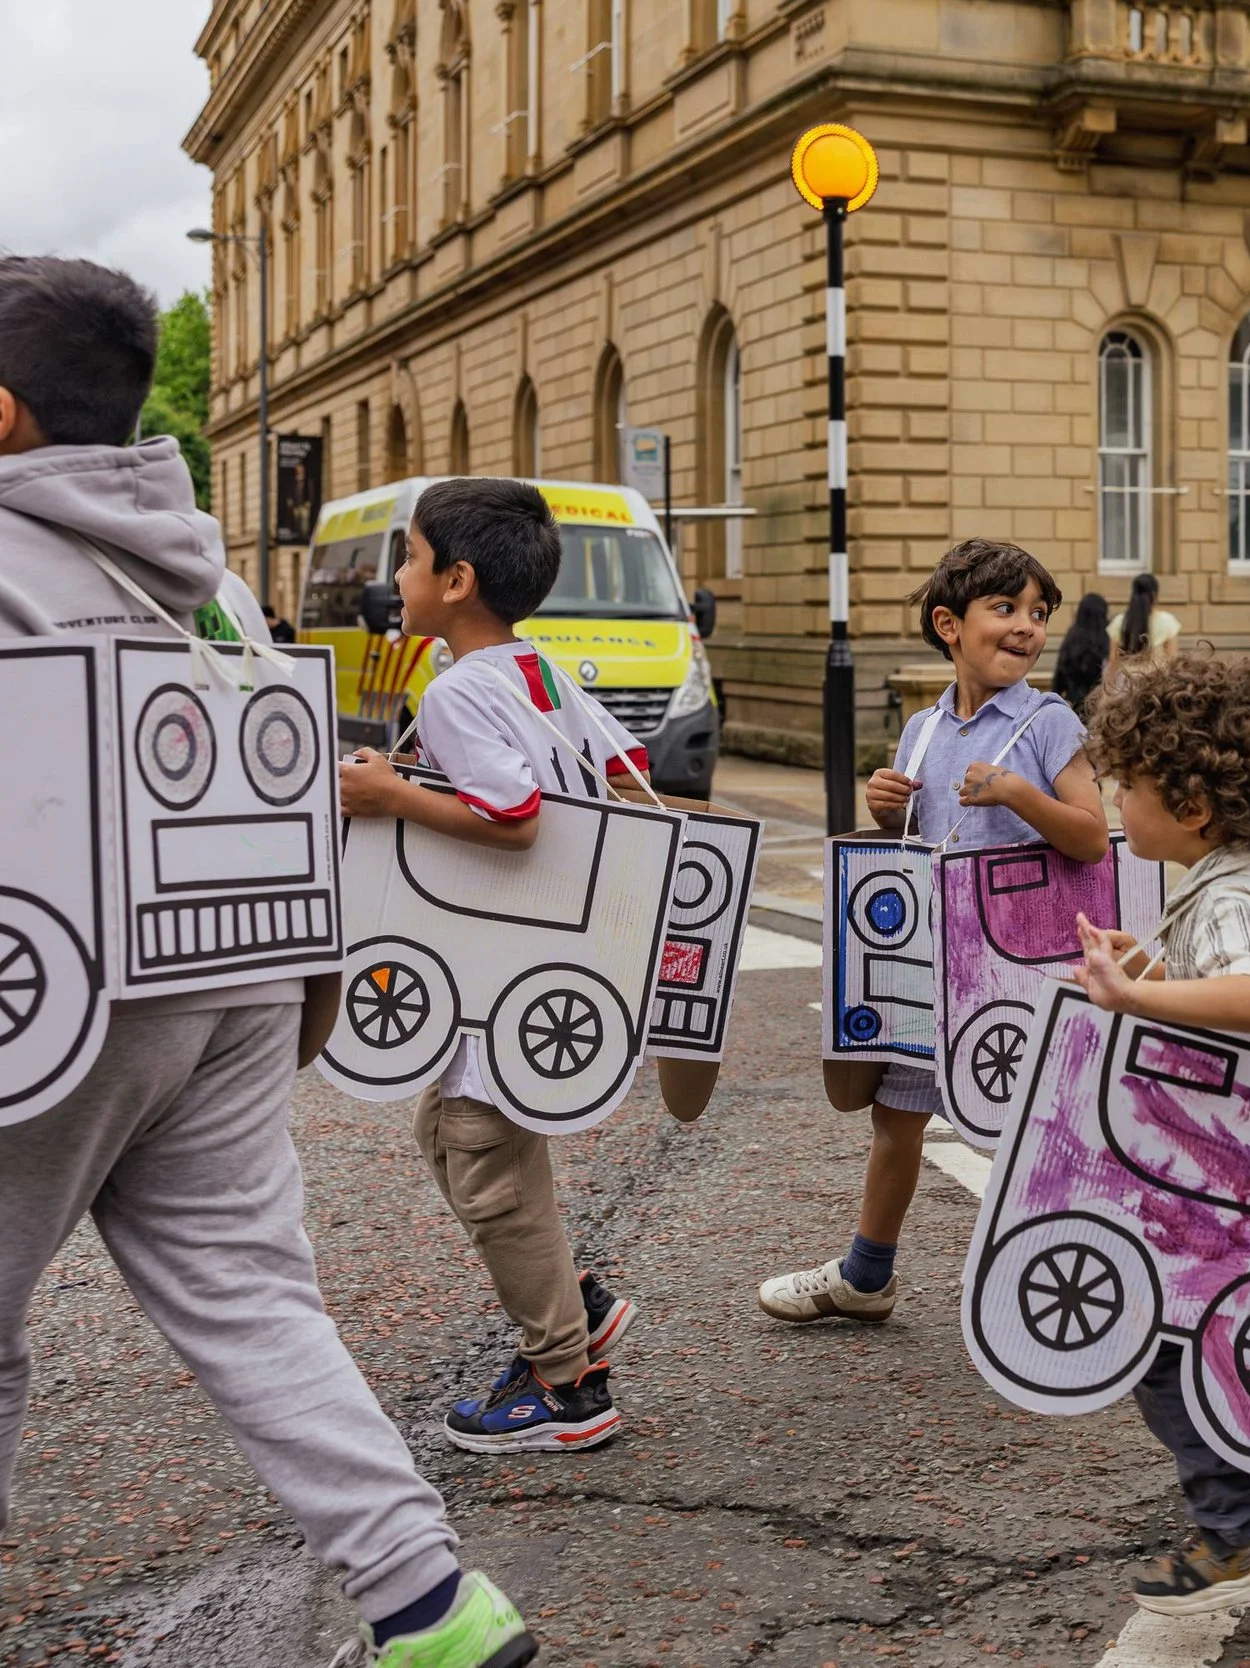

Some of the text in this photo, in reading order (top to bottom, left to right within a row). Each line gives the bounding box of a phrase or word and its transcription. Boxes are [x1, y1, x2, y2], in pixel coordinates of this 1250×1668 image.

[551, 503, 634, 525] EDICAL
[130, 615, 159, 625] CLUB
[526, 634, 656, 648] BULANCE
